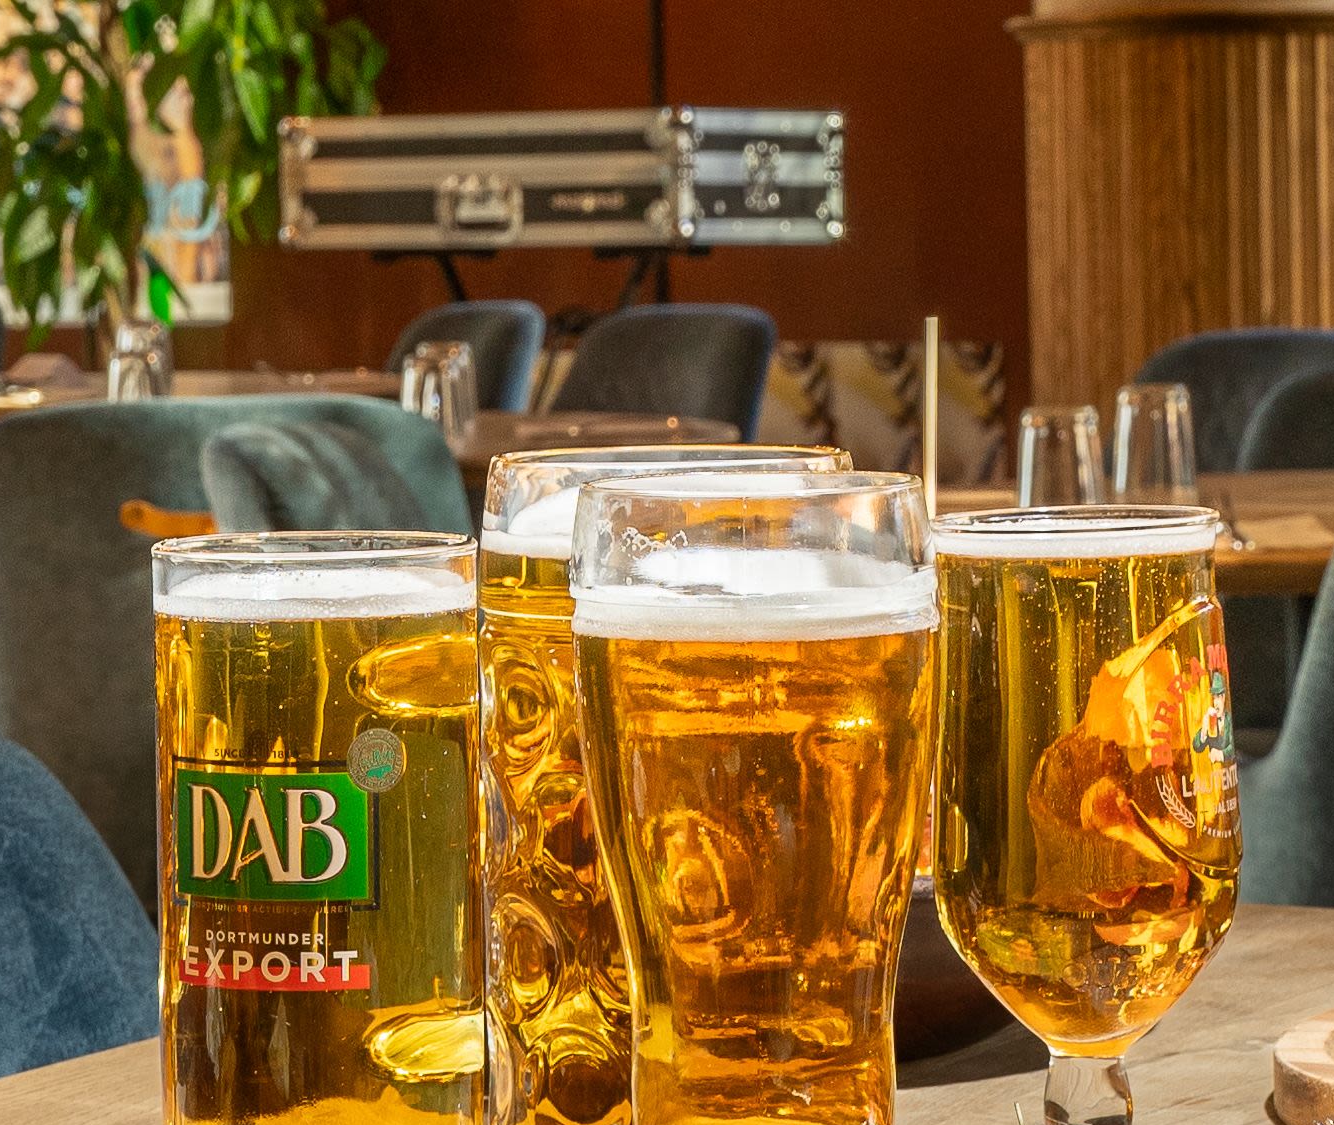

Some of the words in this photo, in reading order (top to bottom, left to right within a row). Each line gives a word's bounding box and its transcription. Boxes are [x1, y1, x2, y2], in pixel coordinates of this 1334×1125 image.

[189, 783, 347, 884] DAB
[205, 929, 325, 945] DORTMUNDER
[184, 945, 358, 983] EXPORT
